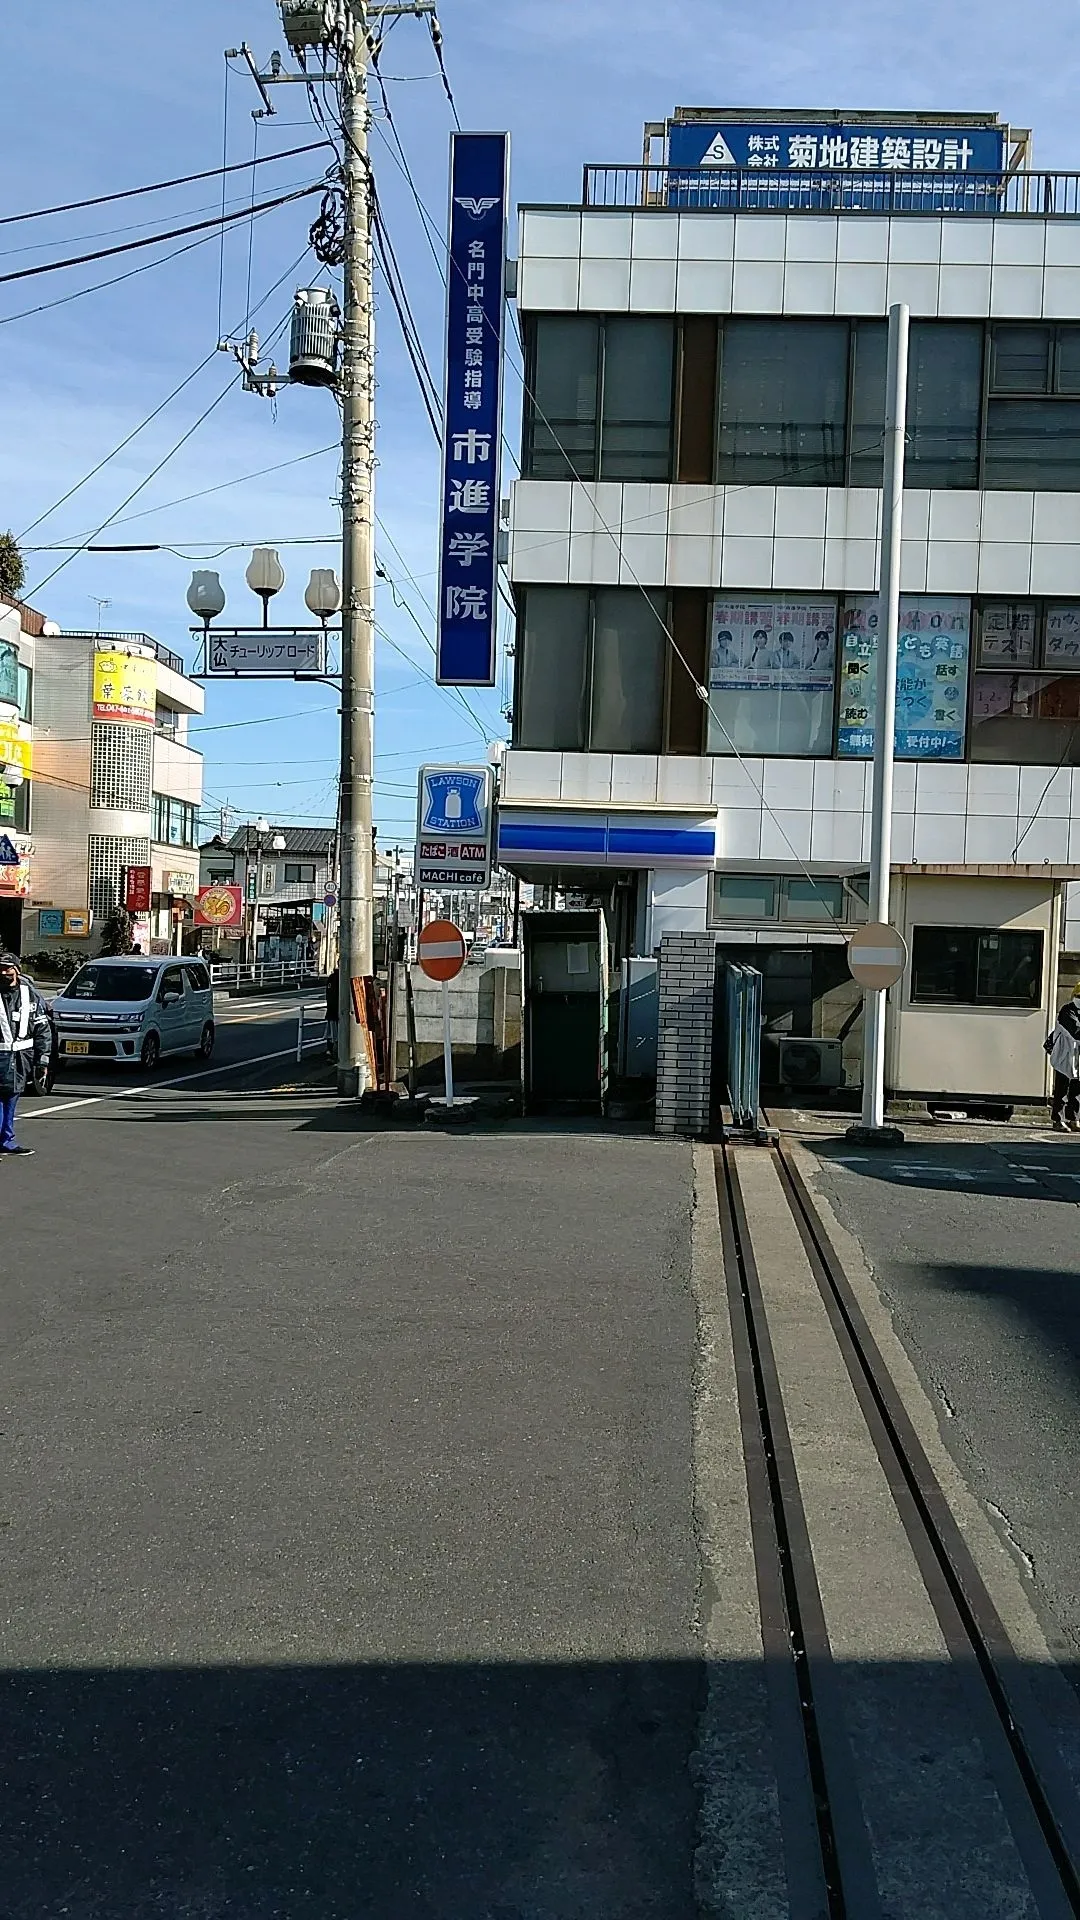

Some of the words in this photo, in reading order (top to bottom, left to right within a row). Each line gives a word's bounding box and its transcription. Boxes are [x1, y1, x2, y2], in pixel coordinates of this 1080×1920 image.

[748, 135, 780, 151] 株式
[788, 135, 973, 170] 菊地建築設計
[748, 153, 779, 167] 会社
[463, 240, 485, 410] 名門中高受験指導
[446, 428, 492, 620] 市進学院
[984, 635, 1031, 653] テスト
[230, 644, 315, 659] チューリップロード
[936, 664, 959, 677] 話す
[430, 776, 478, 788] LAWSON
[430, 816, 476, 828] STATION
[421, 844, 445, 857] たばこ
[461, 846, 485, 858] ATM
[422, 870, 458, 882] MACHI
